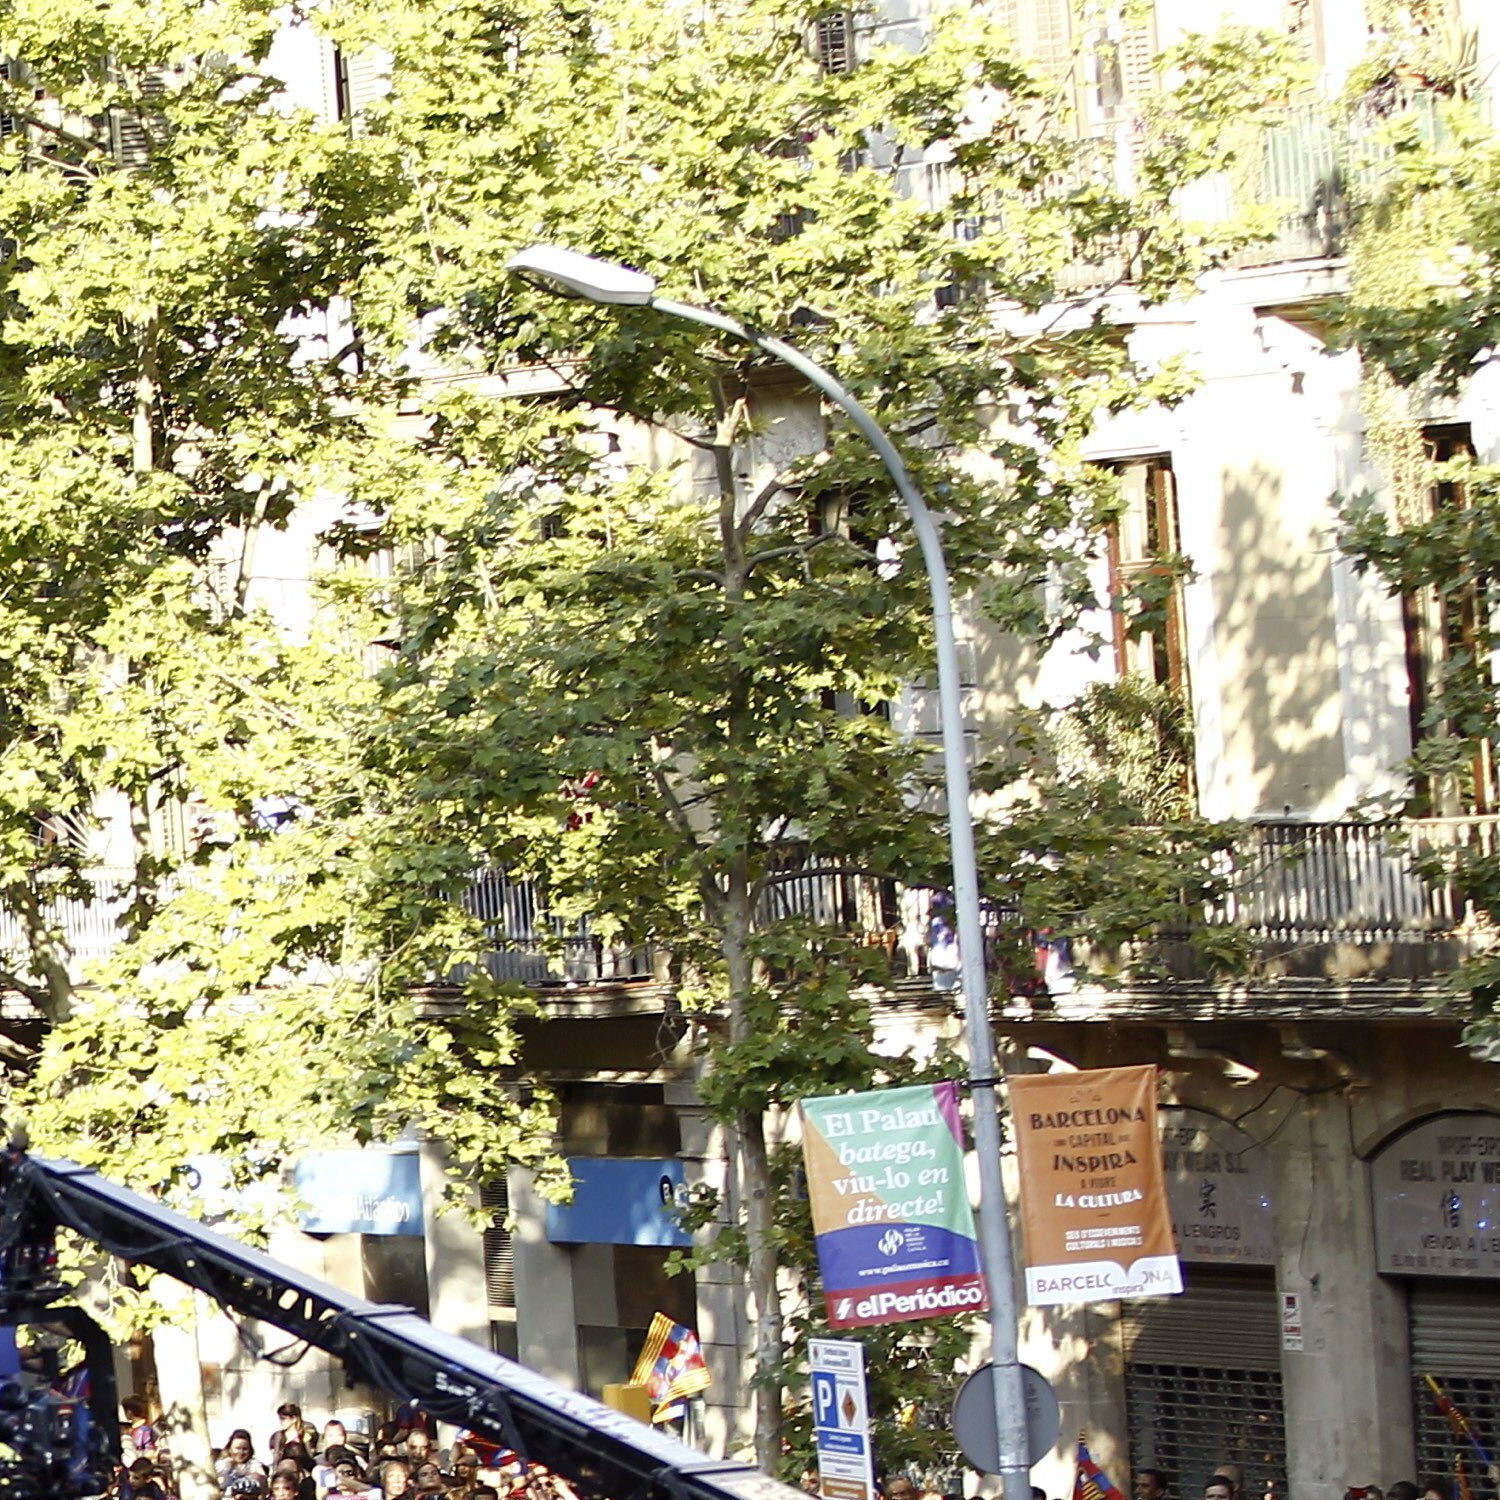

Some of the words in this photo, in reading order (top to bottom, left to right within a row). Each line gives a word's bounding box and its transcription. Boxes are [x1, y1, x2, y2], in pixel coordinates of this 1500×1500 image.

[823, 1113, 856, 1138] El
[858, 1107, 940, 1133] Palau
[1030, 1107, 1147, 1130] BARCELONA
[838, 1140, 936, 1166] batega,
[1068, 1132, 1116, 1148] CAPITAL
[1053, 1151, 1137, 1172] INSPIRA
[832, 1166, 910, 1196] viu-lo
[918, 1168, 949, 1186] en
[847, 1190, 945, 1224] directe!
[1055, 1193, 1075, 1207] LA
[1078, 1188, 1142, 1208] CULTURA
[816, 1379, 832, 1422] P
